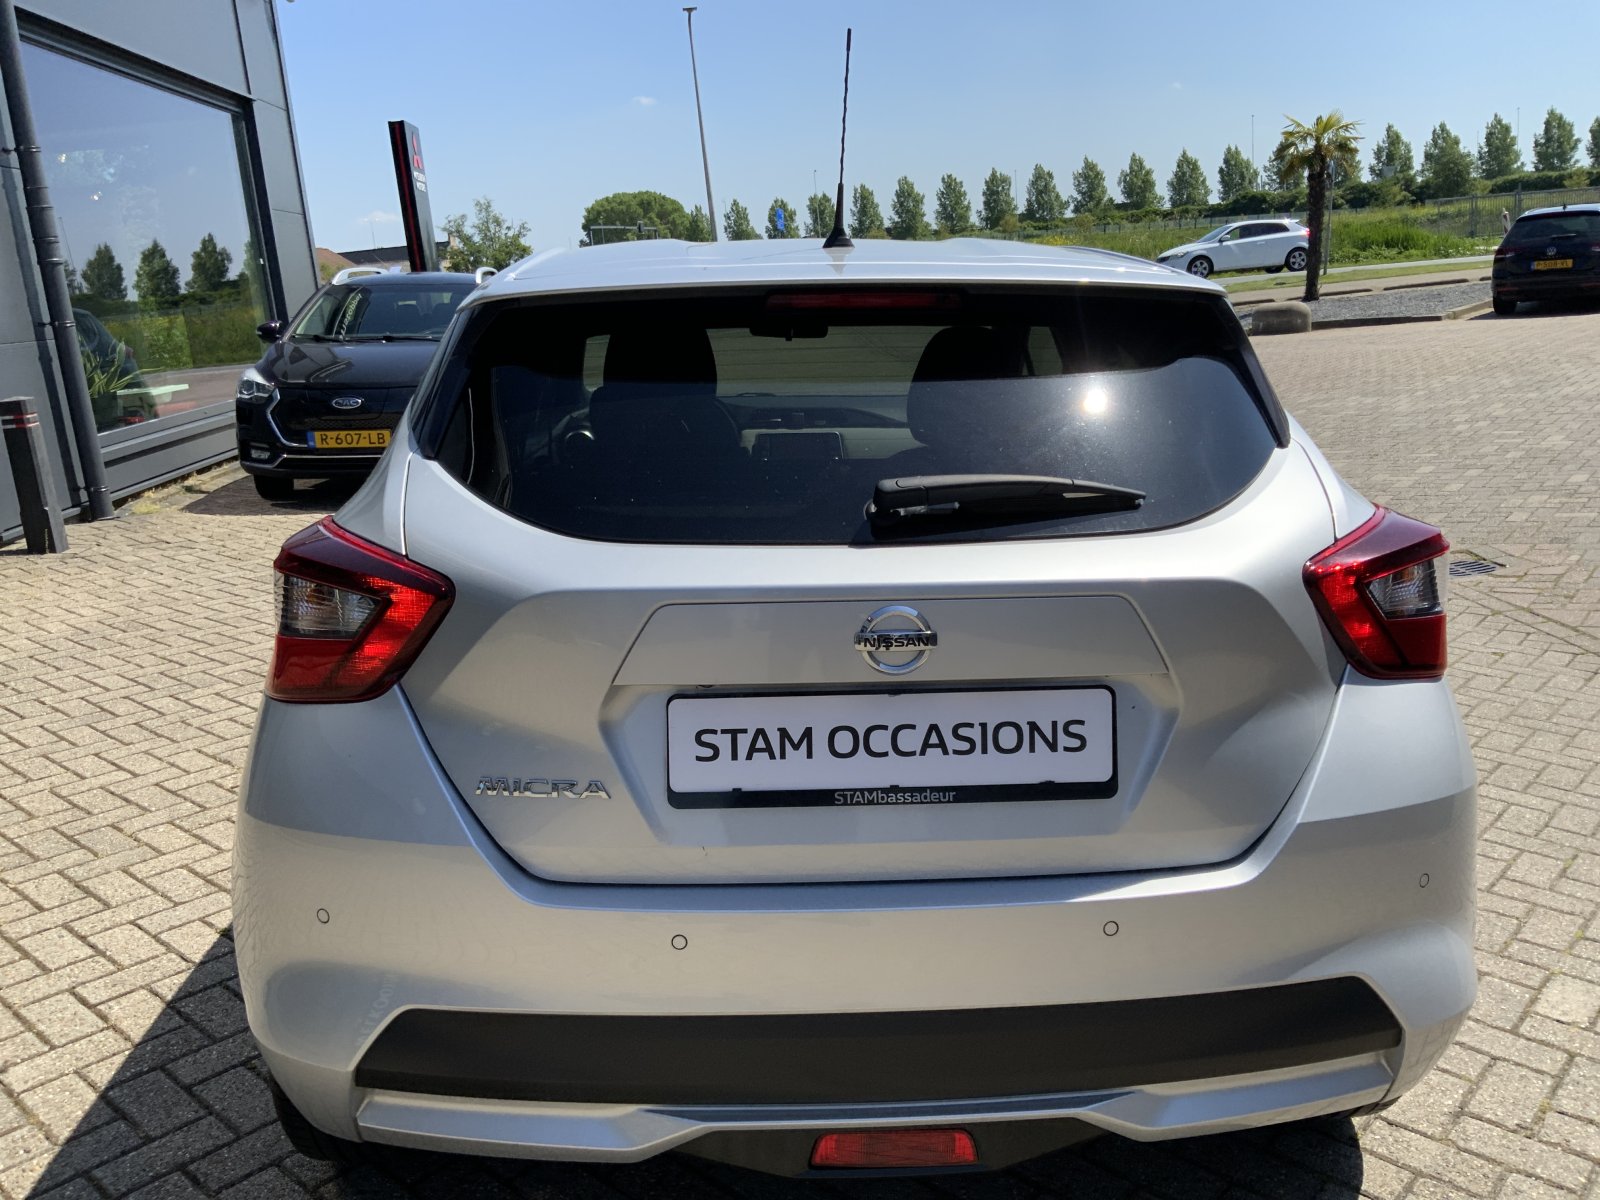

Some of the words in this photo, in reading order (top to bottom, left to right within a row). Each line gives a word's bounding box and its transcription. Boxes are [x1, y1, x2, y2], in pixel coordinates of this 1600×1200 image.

[319, 433, 386, 445] R-607-LB
[693, 726, 814, 763] STAM
[827, 719, 1088, 758] OCCASIONS
[475, 776, 611, 799] MICRA
[834, 789, 957, 805] STAMbassadeur
